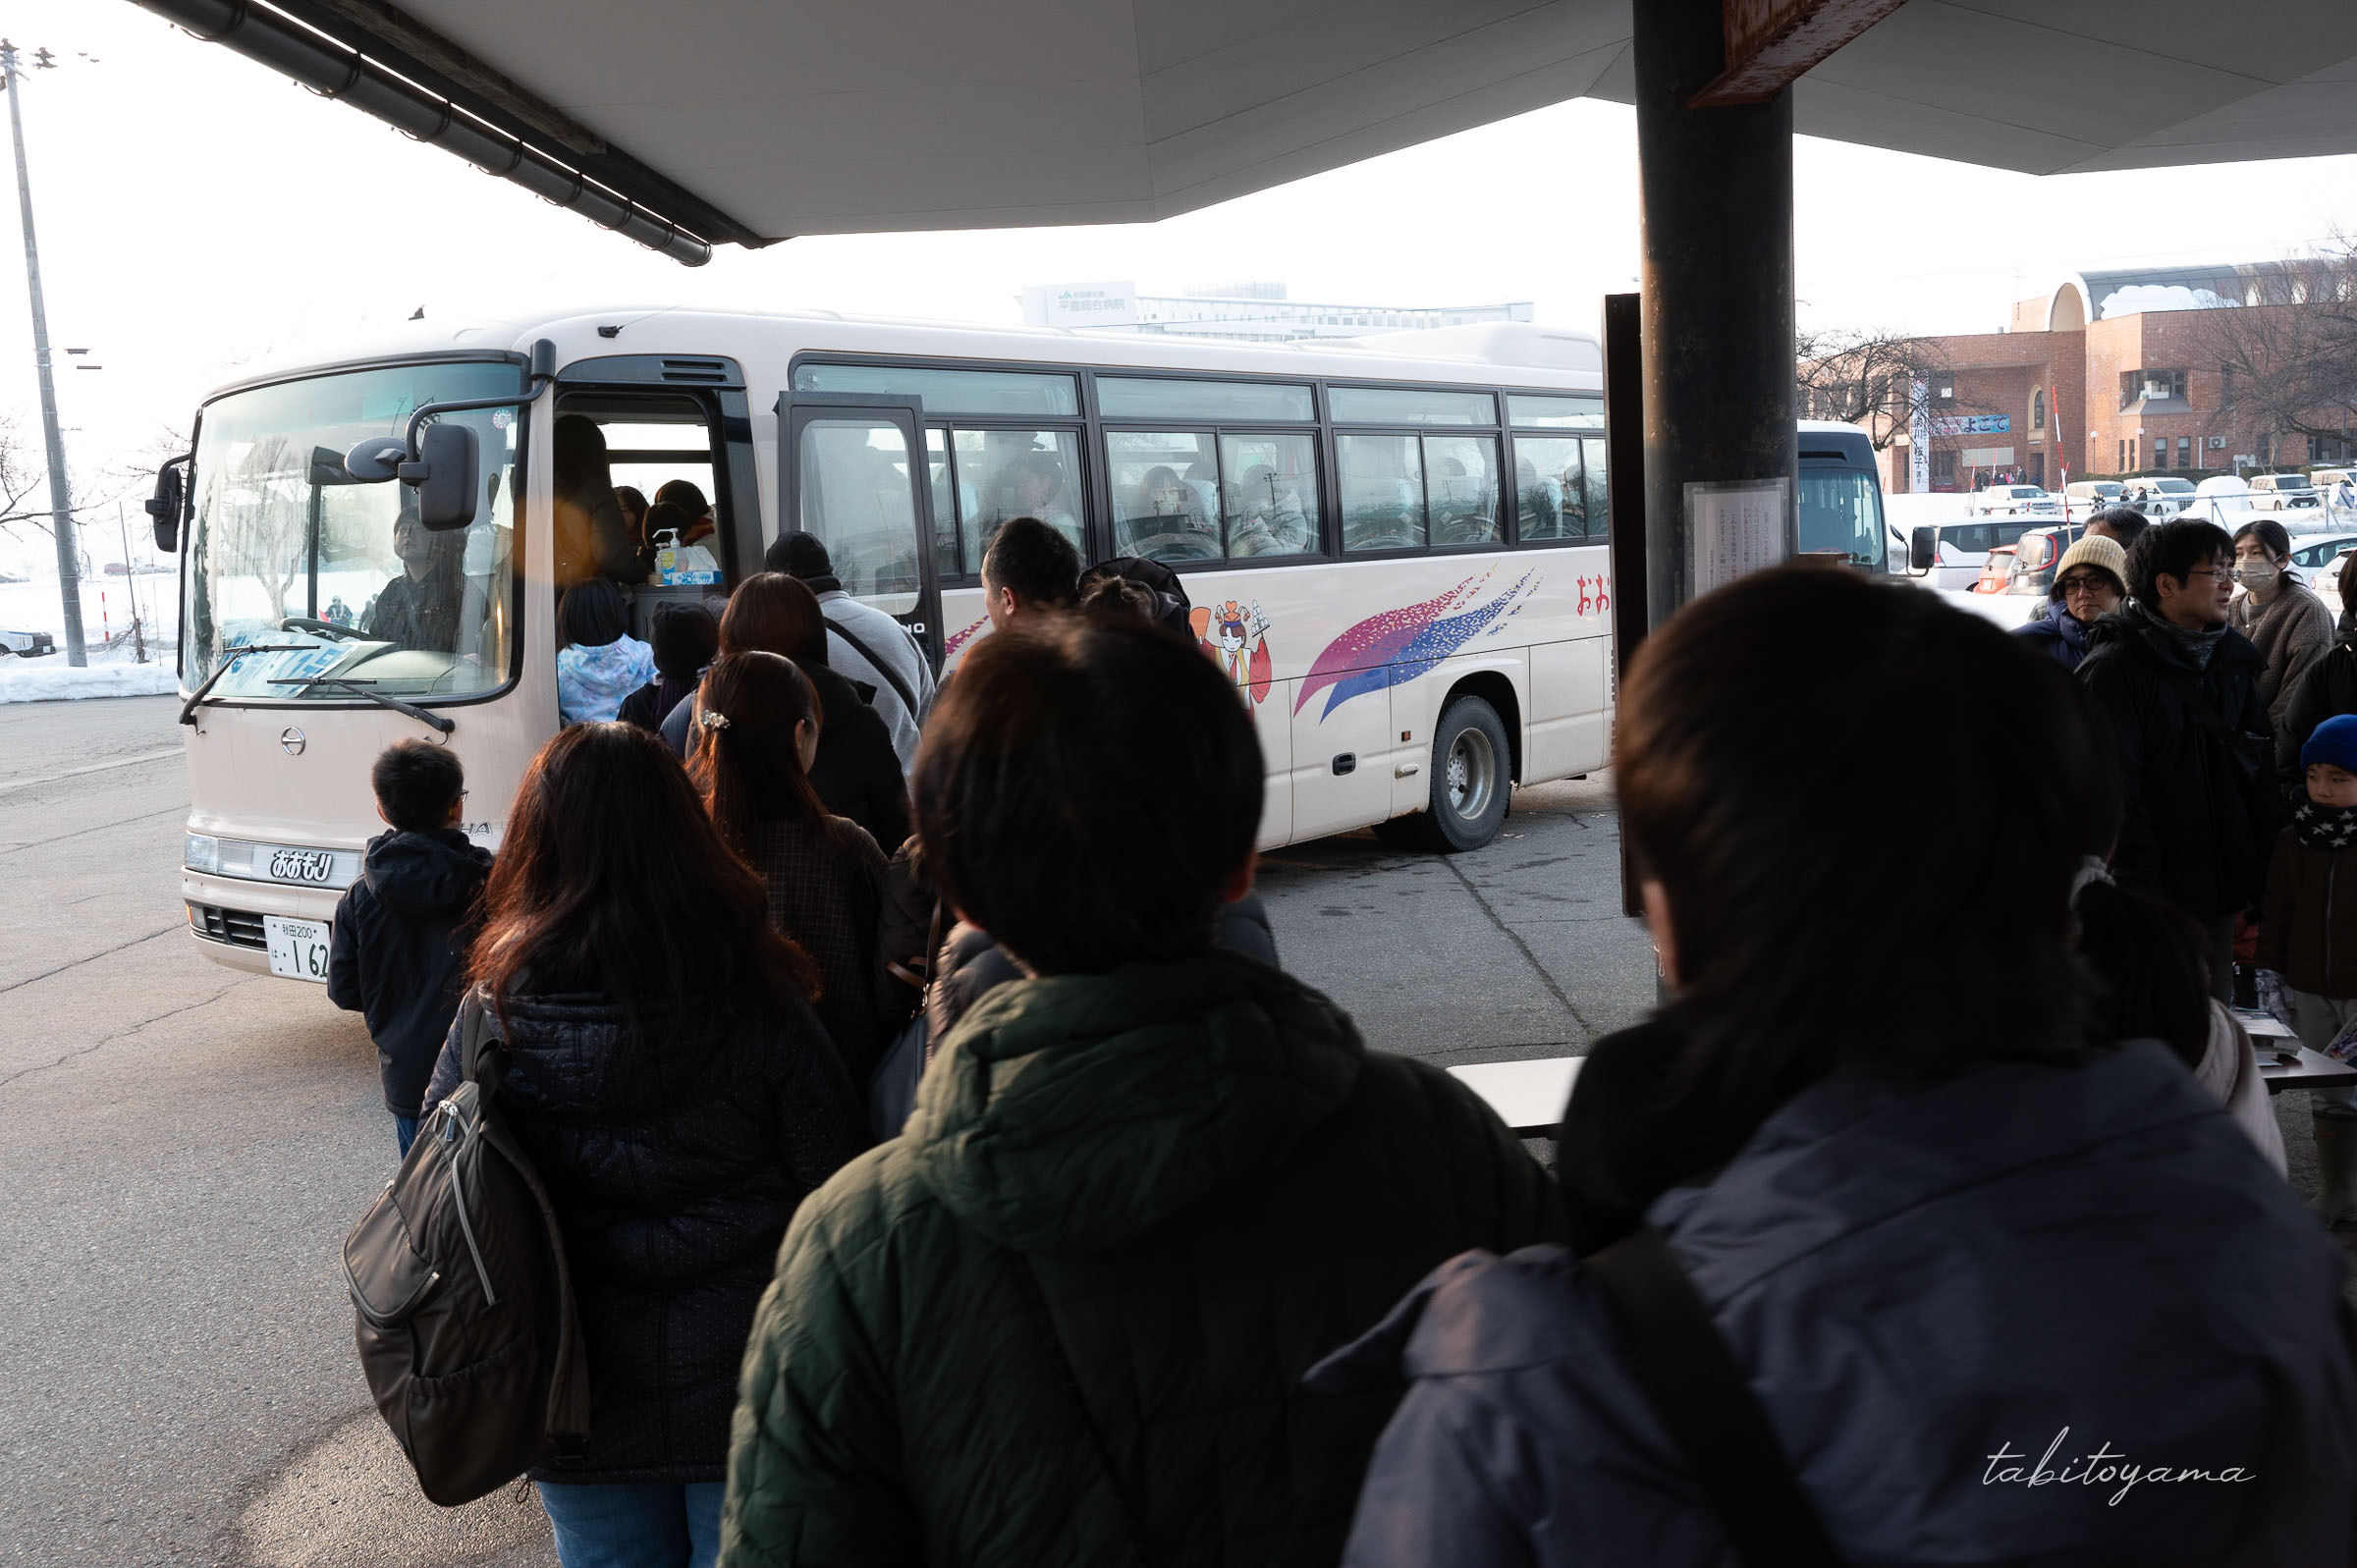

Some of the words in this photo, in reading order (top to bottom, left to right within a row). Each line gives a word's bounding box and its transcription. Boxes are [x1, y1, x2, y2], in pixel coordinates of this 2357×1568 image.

[1964, 416, 2006, 433] よこて
[270, 849, 333, 882] おおもり
